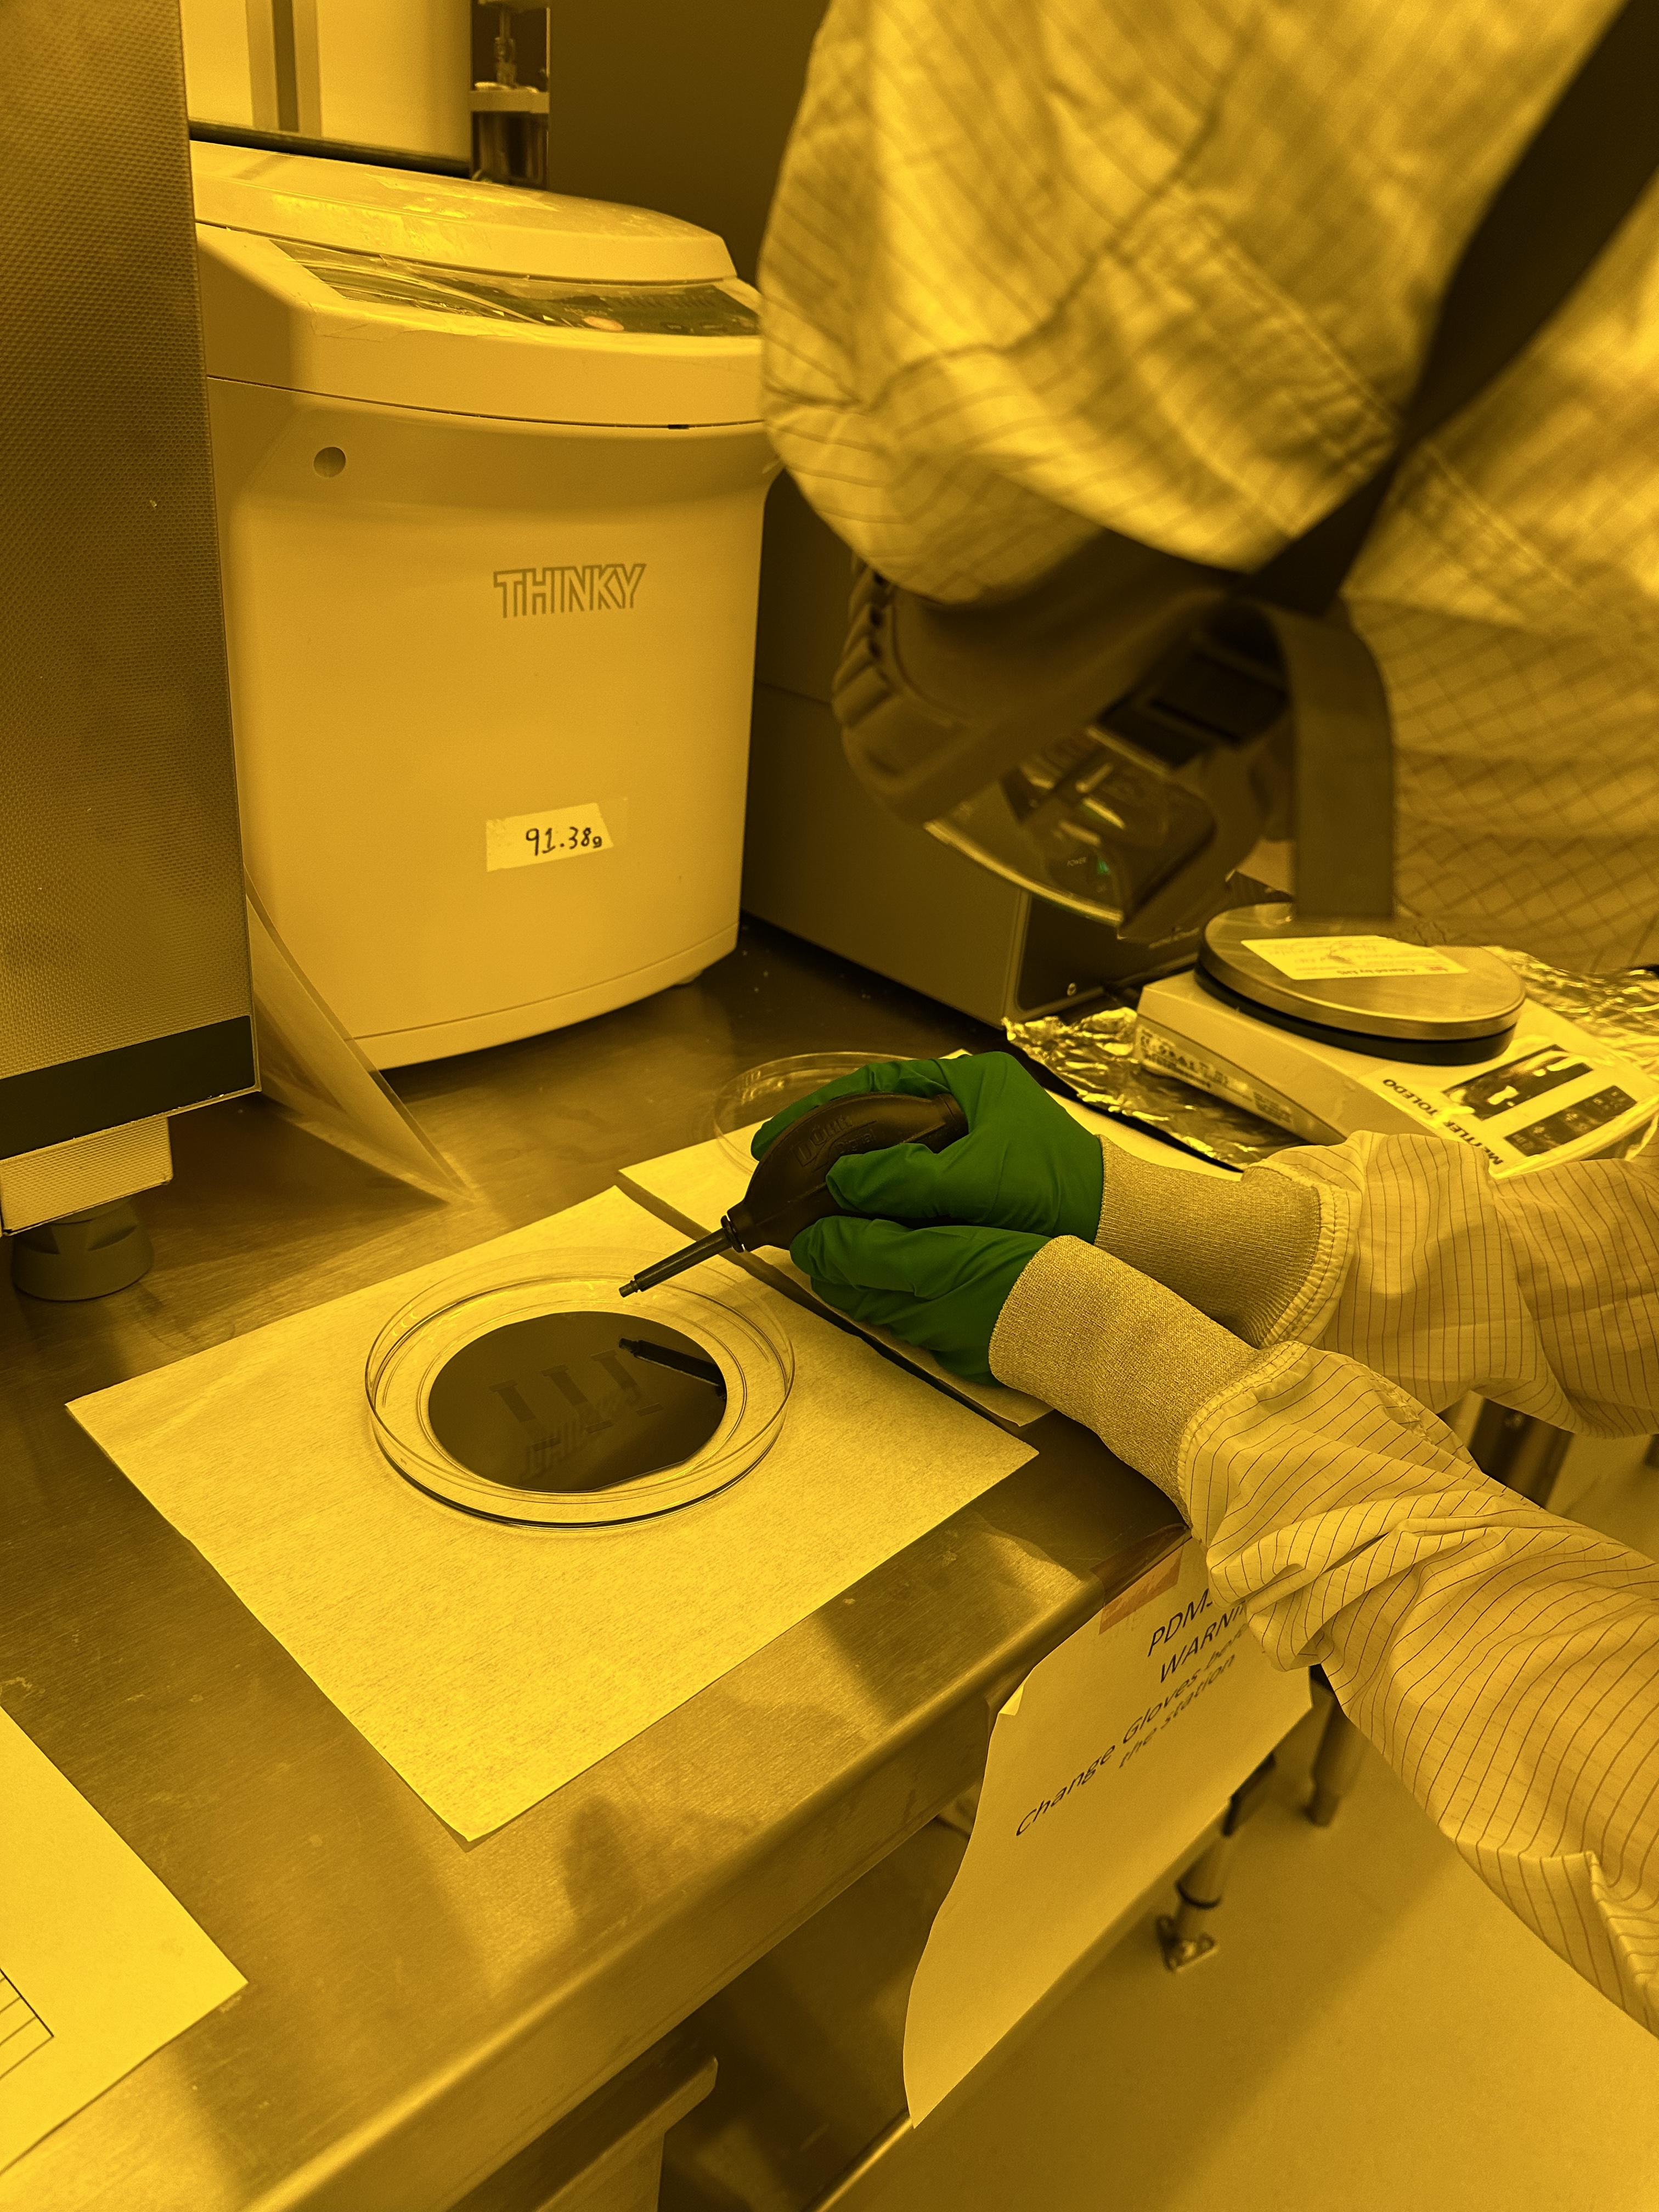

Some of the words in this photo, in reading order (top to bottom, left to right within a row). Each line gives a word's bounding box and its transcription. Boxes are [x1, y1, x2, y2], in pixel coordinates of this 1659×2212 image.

[493, 563, 647, 618] THINKY
[525, 826, 602, 856] 91.38g
[1383, 1079, 1437, 1115] TOLEDO
[1147, 1588, 1213, 1657] PDM
[1160, 1600, 1246, 1683] WARNI
[1119, 1728, 1157, 1769] the
[1160, 1654, 1235, 1729] station
[1016, 1745, 1115, 1836] Change
[1122, 1668, 1201, 1744] Gloves
